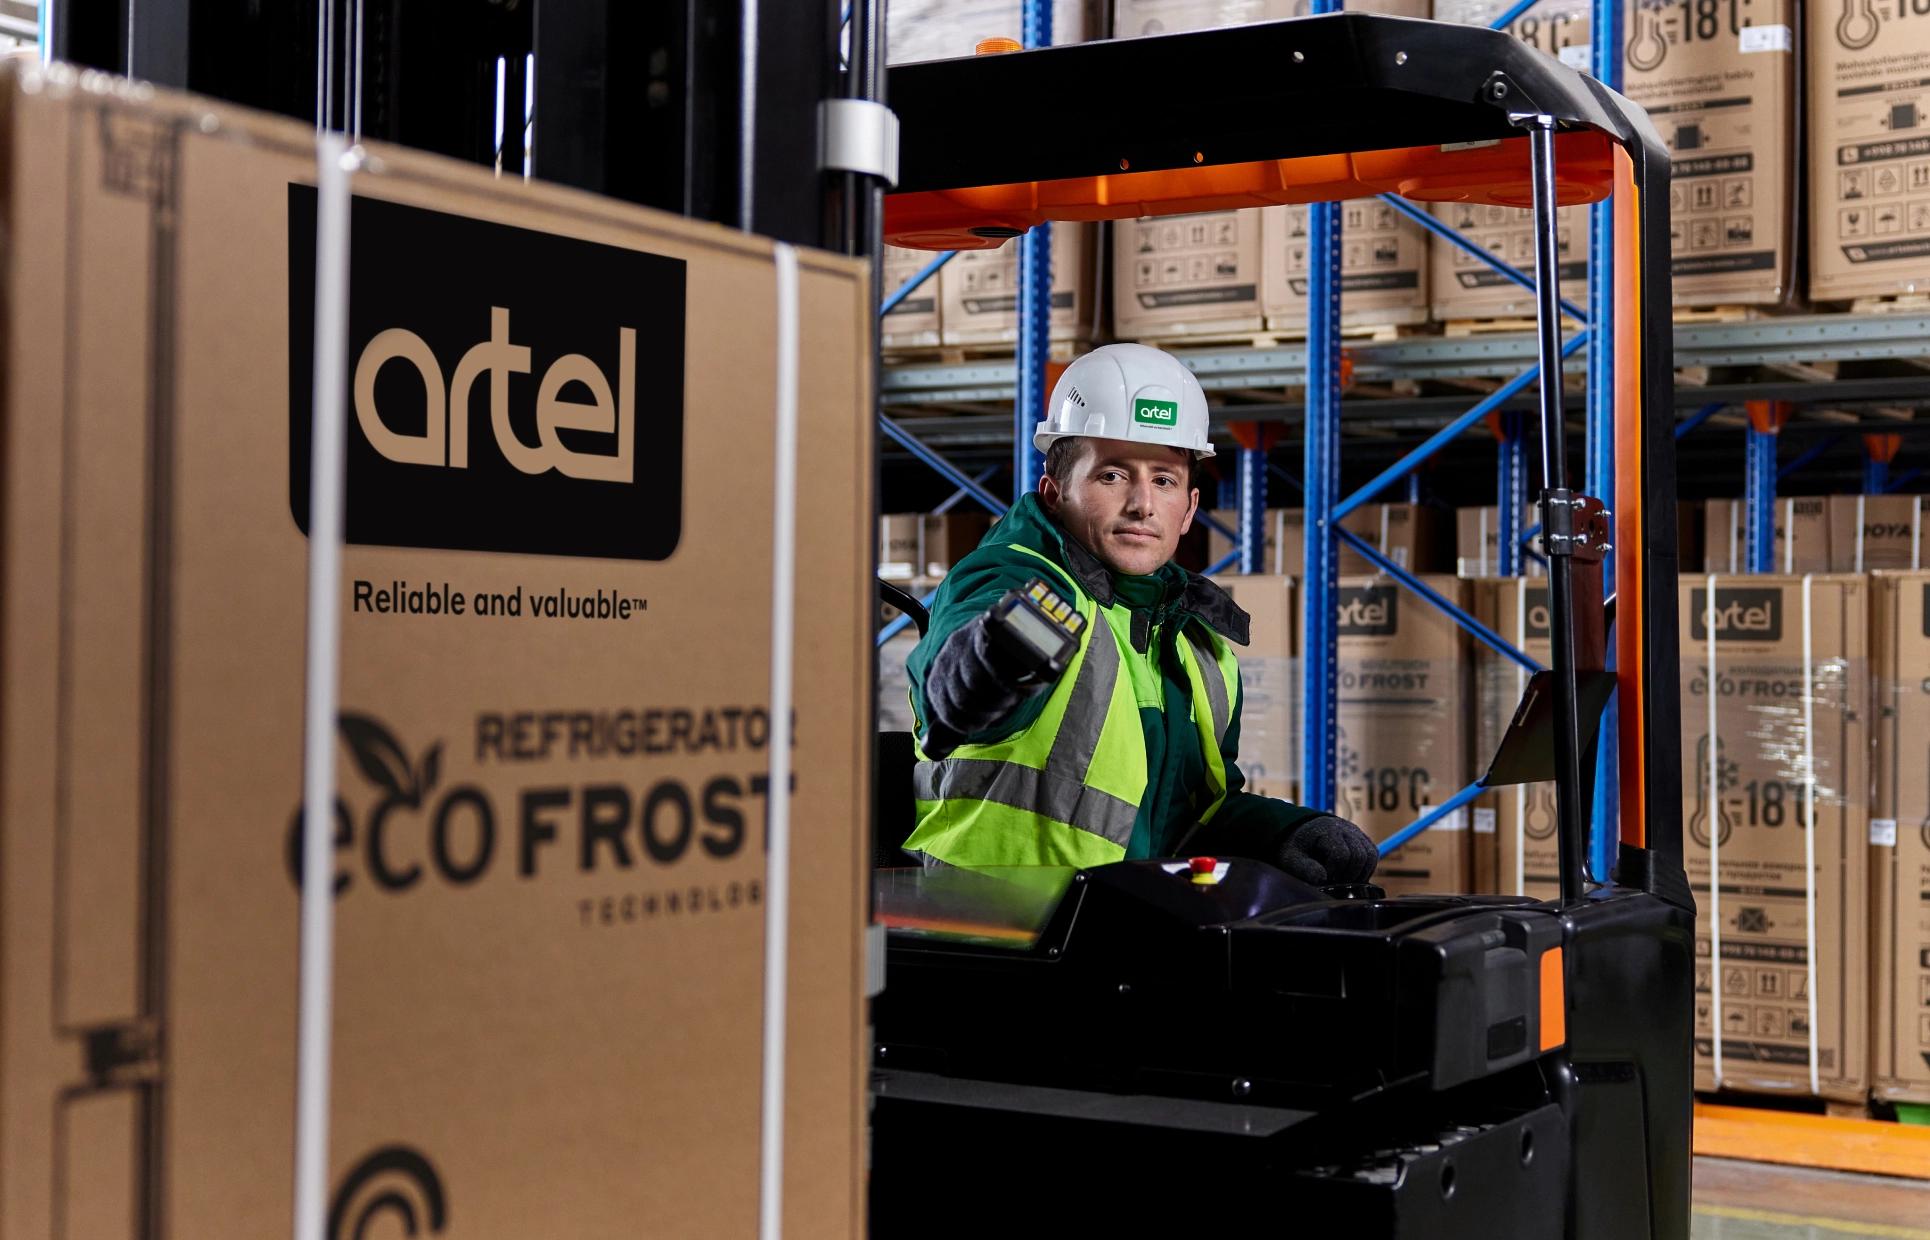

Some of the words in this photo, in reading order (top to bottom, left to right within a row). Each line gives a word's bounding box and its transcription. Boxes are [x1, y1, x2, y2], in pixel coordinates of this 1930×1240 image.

[354, 306, 637, 484] artel
[1140, 405, 1172, 420] artel
[353, 580, 466, 616] Reliable
[473, 586, 522, 617] and
[1739, 680, 1816, 698] FROS
[577, 879, 766, 927] TECHNOLOG
